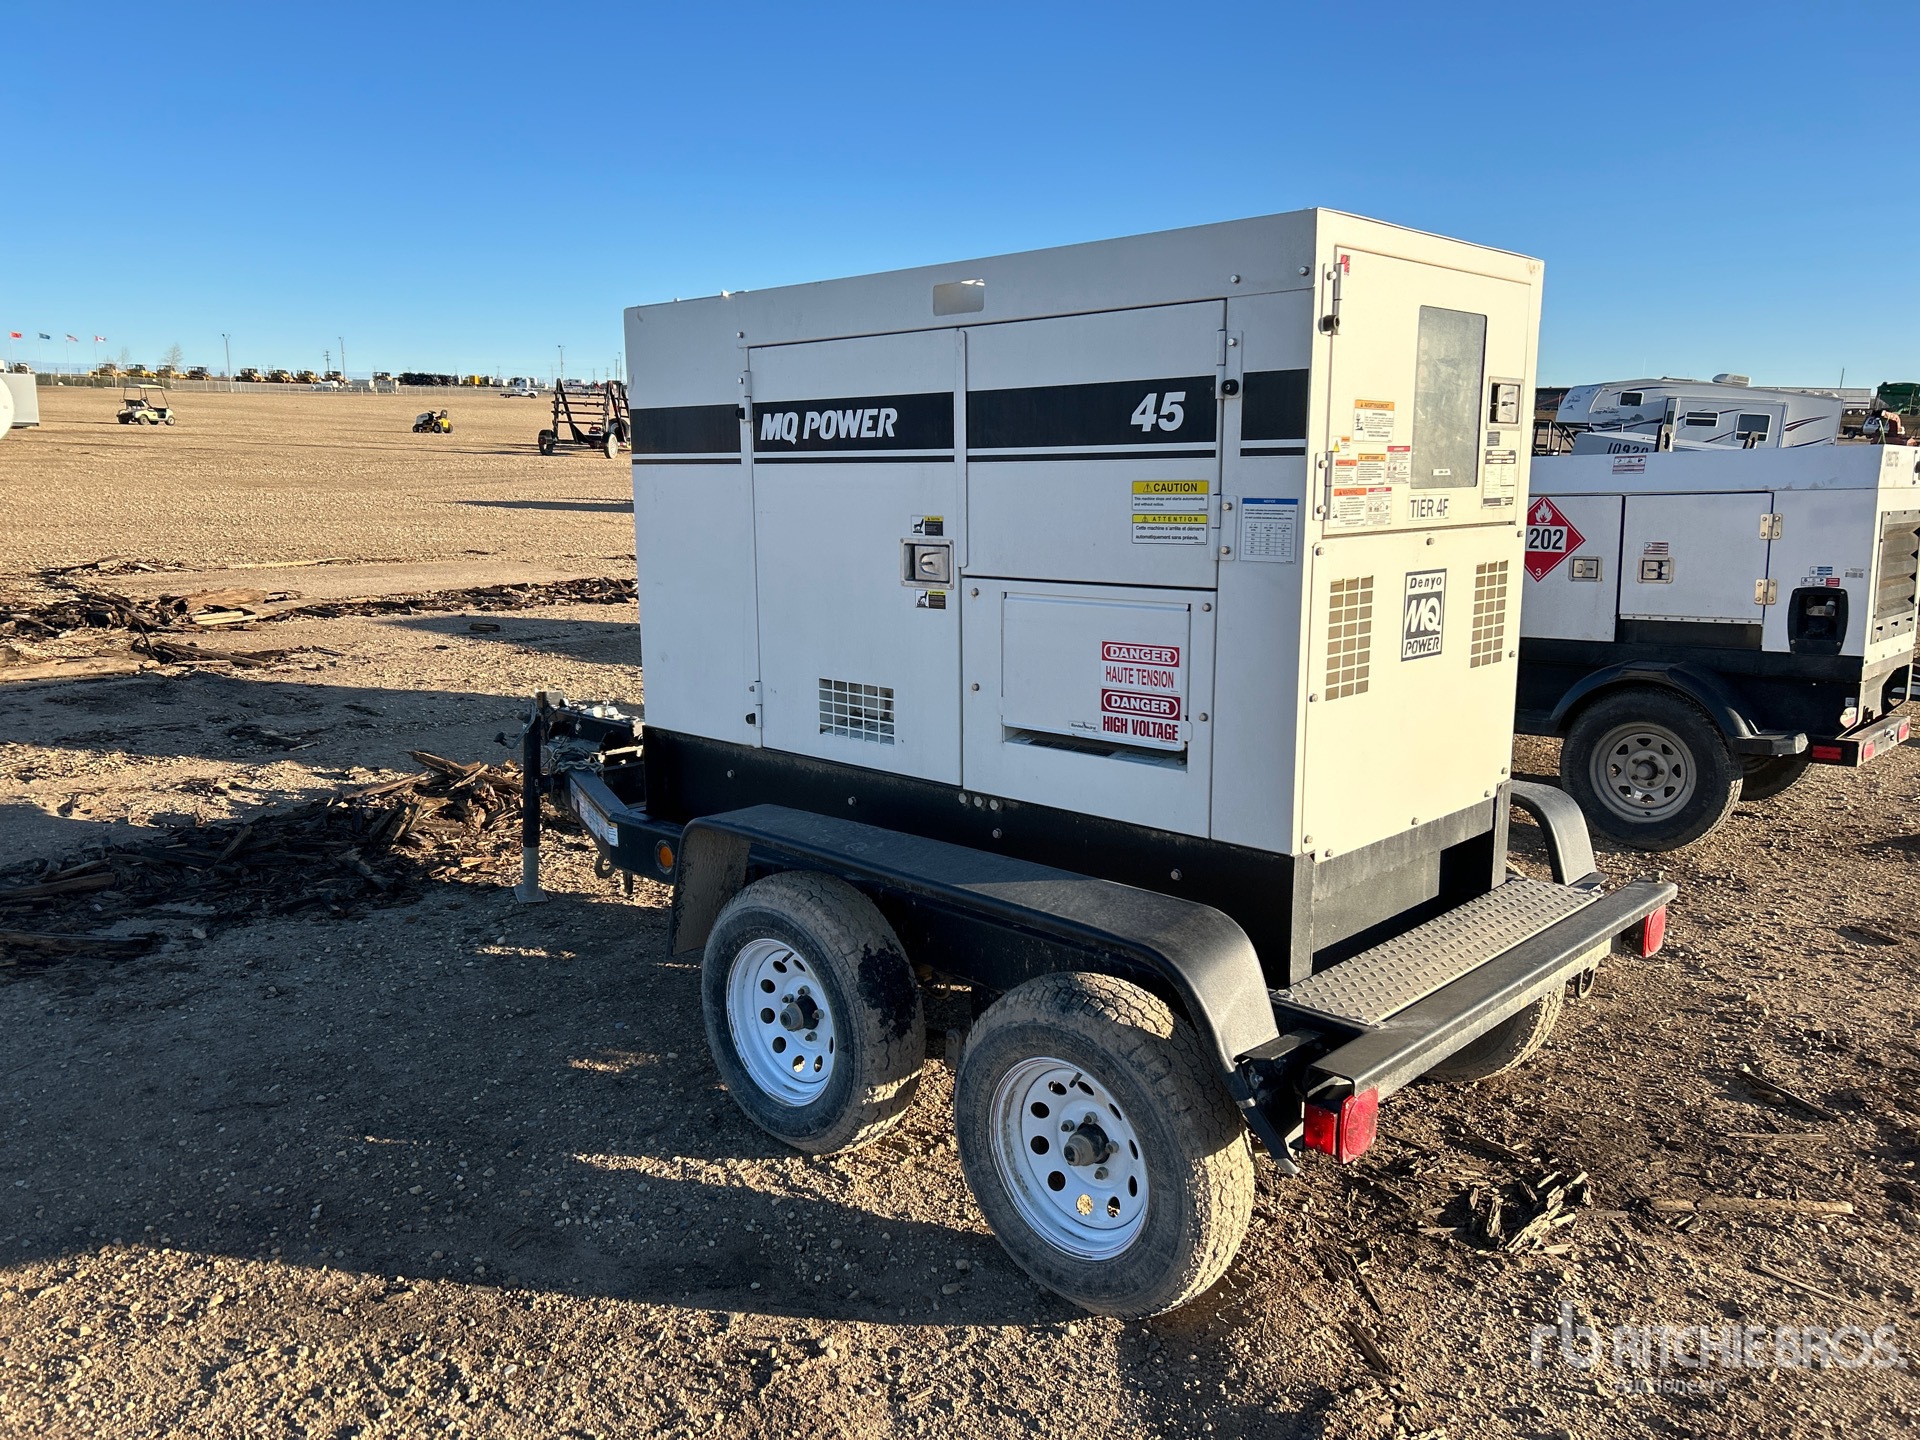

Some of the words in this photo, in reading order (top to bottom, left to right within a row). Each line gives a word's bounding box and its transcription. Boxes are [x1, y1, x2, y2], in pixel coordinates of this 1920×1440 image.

[1130, 391, 1186, 432] 45
[760, 413, 798, 444] MQ
[803, 407, 898, 441] POWER
[1153, 483, 1198, 492] CAUTION
[1410, 498, 1434, 518] TIER
[1436, 498, 1449, 517] 4F
[1528, 527, 1564, 551] 202
[1535, 567, 1542, 577] 3
[1409, 576, 1442, 590] Denyo
[1405, 596, 1441, 633] MQ
[1109, 646, 1172, 662] DANGER
[1404, 636, 1440, 656] POWER
[1105, 665, 1134, 684] HAUTE
[1136, 668, 1174, 689] TENSION
[1111, 695, 1170, 714] DANGER
[1102, 715, 1128, 735] HIGH
[1132, 718, 1179, 741] VOLTAGE
